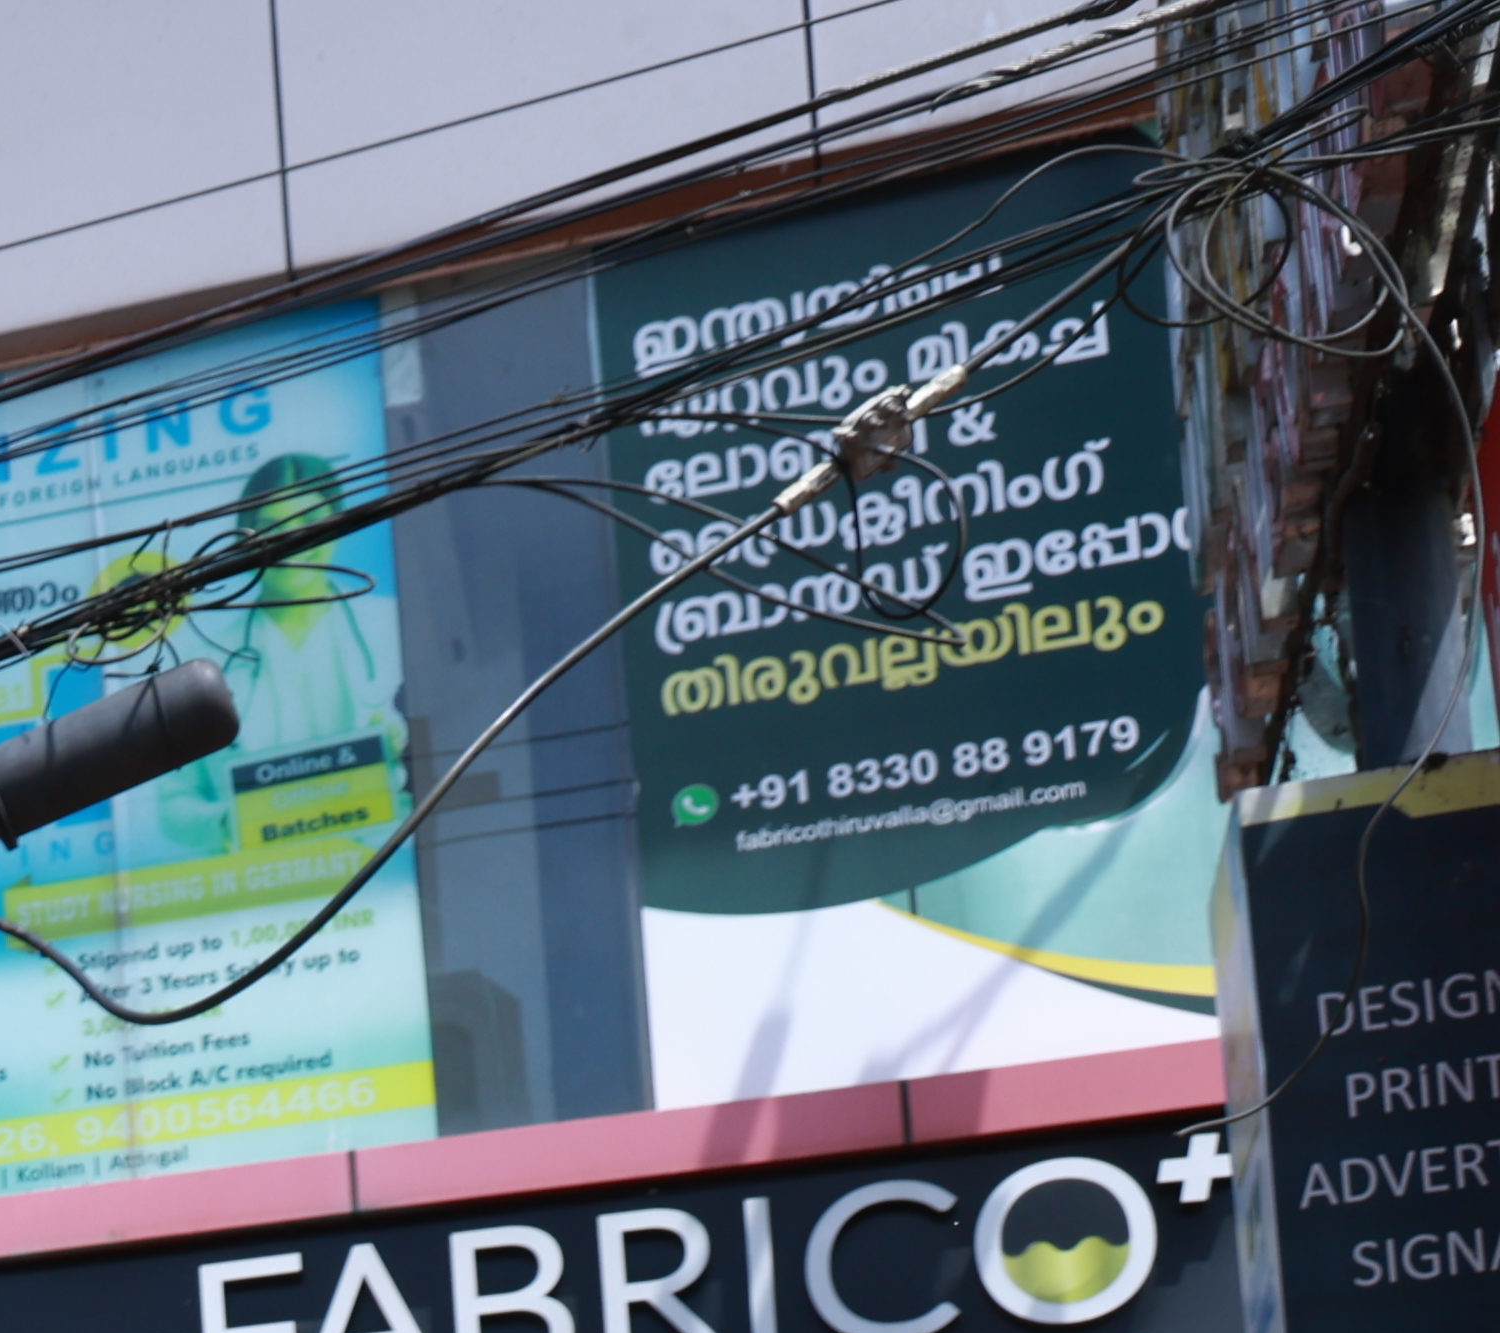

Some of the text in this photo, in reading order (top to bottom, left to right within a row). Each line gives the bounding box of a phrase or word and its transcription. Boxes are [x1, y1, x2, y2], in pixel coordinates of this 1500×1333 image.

[113, 443, 261, 487] LANGUAGES
[254, 751, 333, 785] Online
[730, 715, 1140, 815] +91 8330 88 9179
[260, 805, 370, 843] Batches
[201, 1030, 252, 1052] Fees
[236, 1049, 333, 1083] required
[16, 1157, 86, 1185] Kollam
